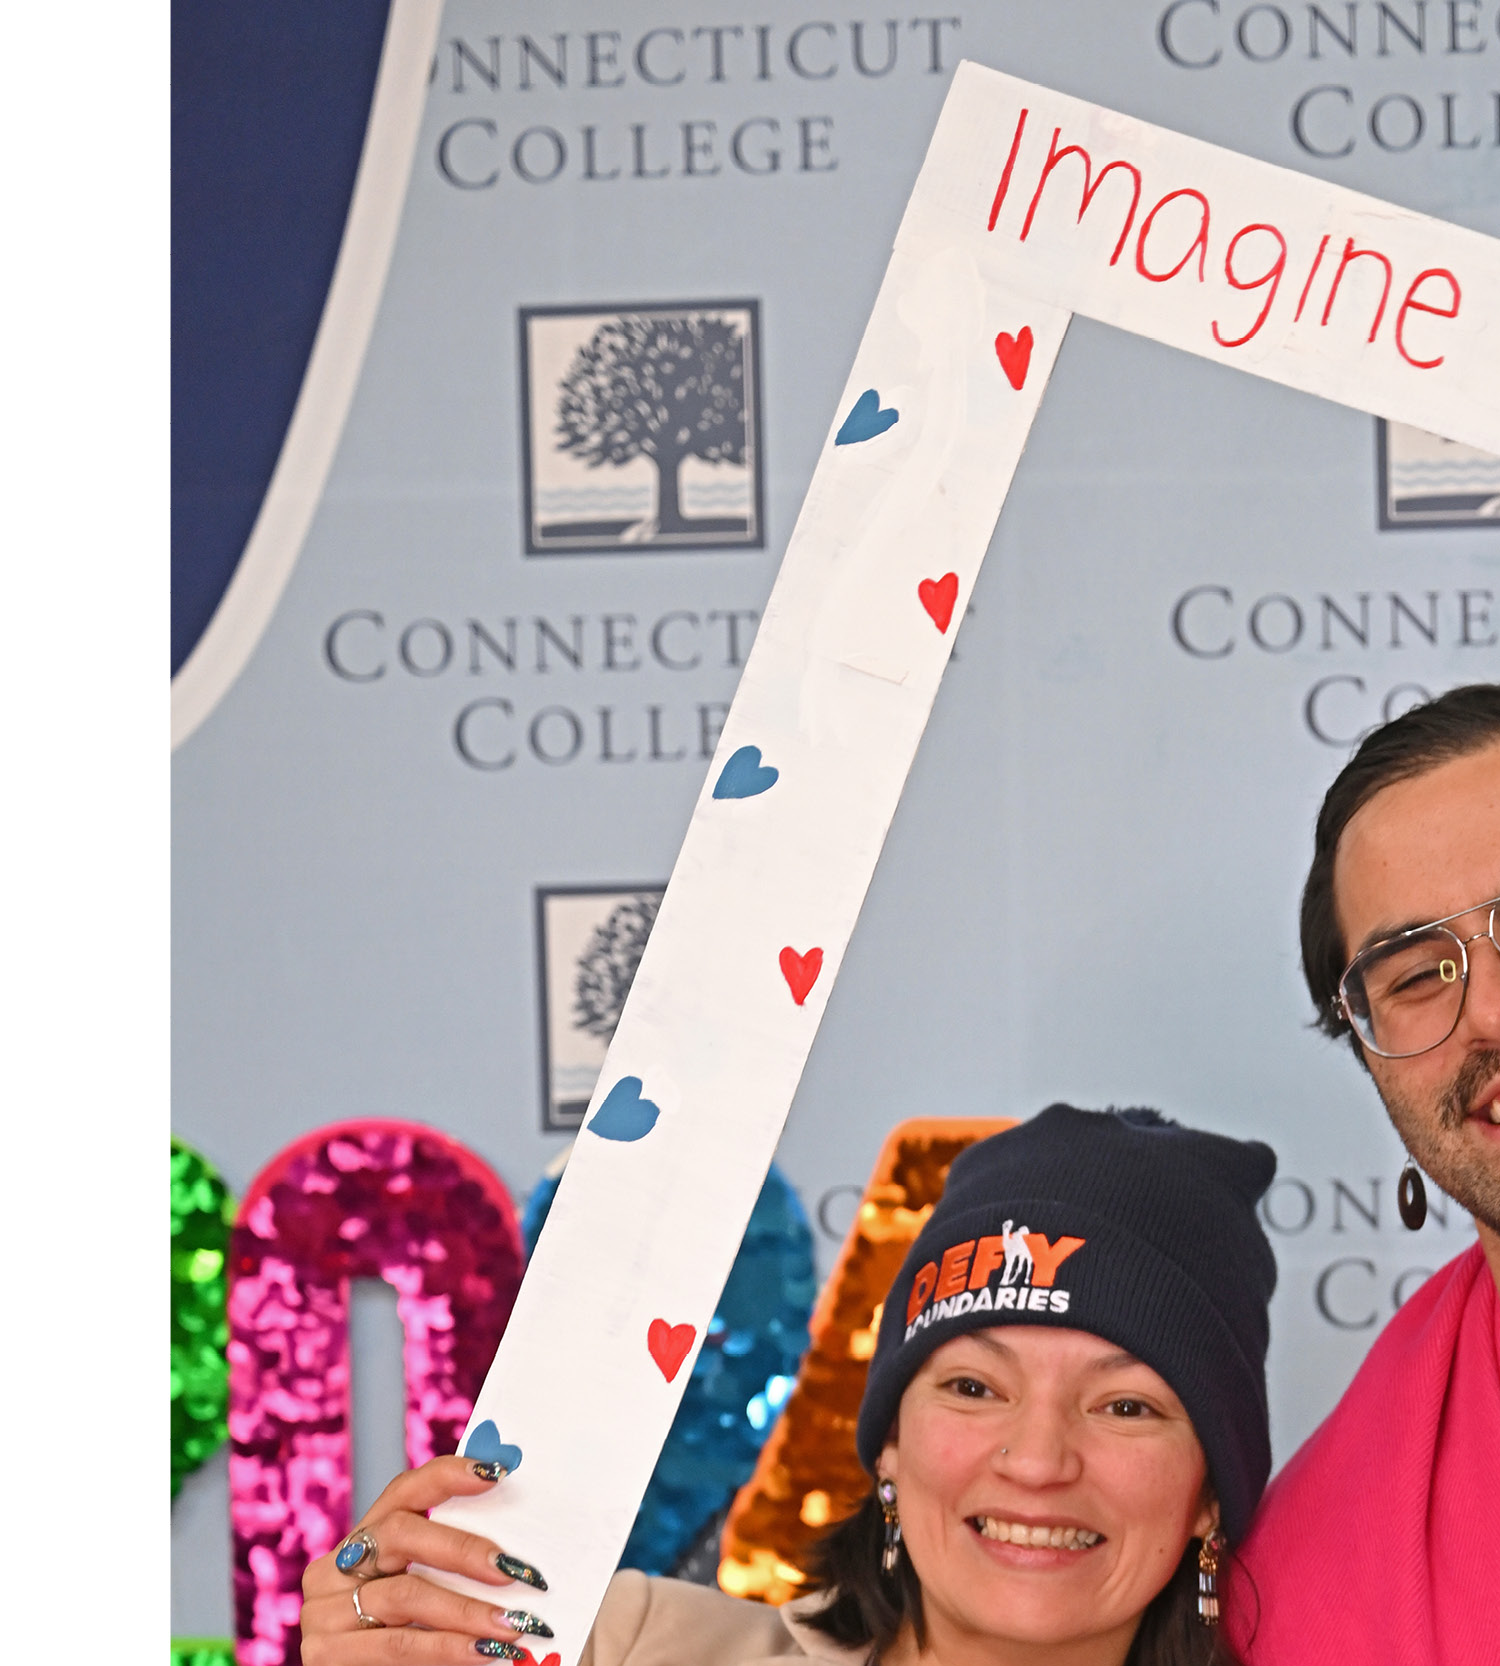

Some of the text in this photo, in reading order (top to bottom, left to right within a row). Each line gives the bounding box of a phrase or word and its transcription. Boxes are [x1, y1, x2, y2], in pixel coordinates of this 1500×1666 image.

[428, 16, 963, 95] NNECTICUT
[434, 116, 841, 191] COLLEGE
[985, 107, 1463, 371] Imagine
[322, 607, 974, 684] CONNECT
[906, 1232, 1087, 1327] DEFY
